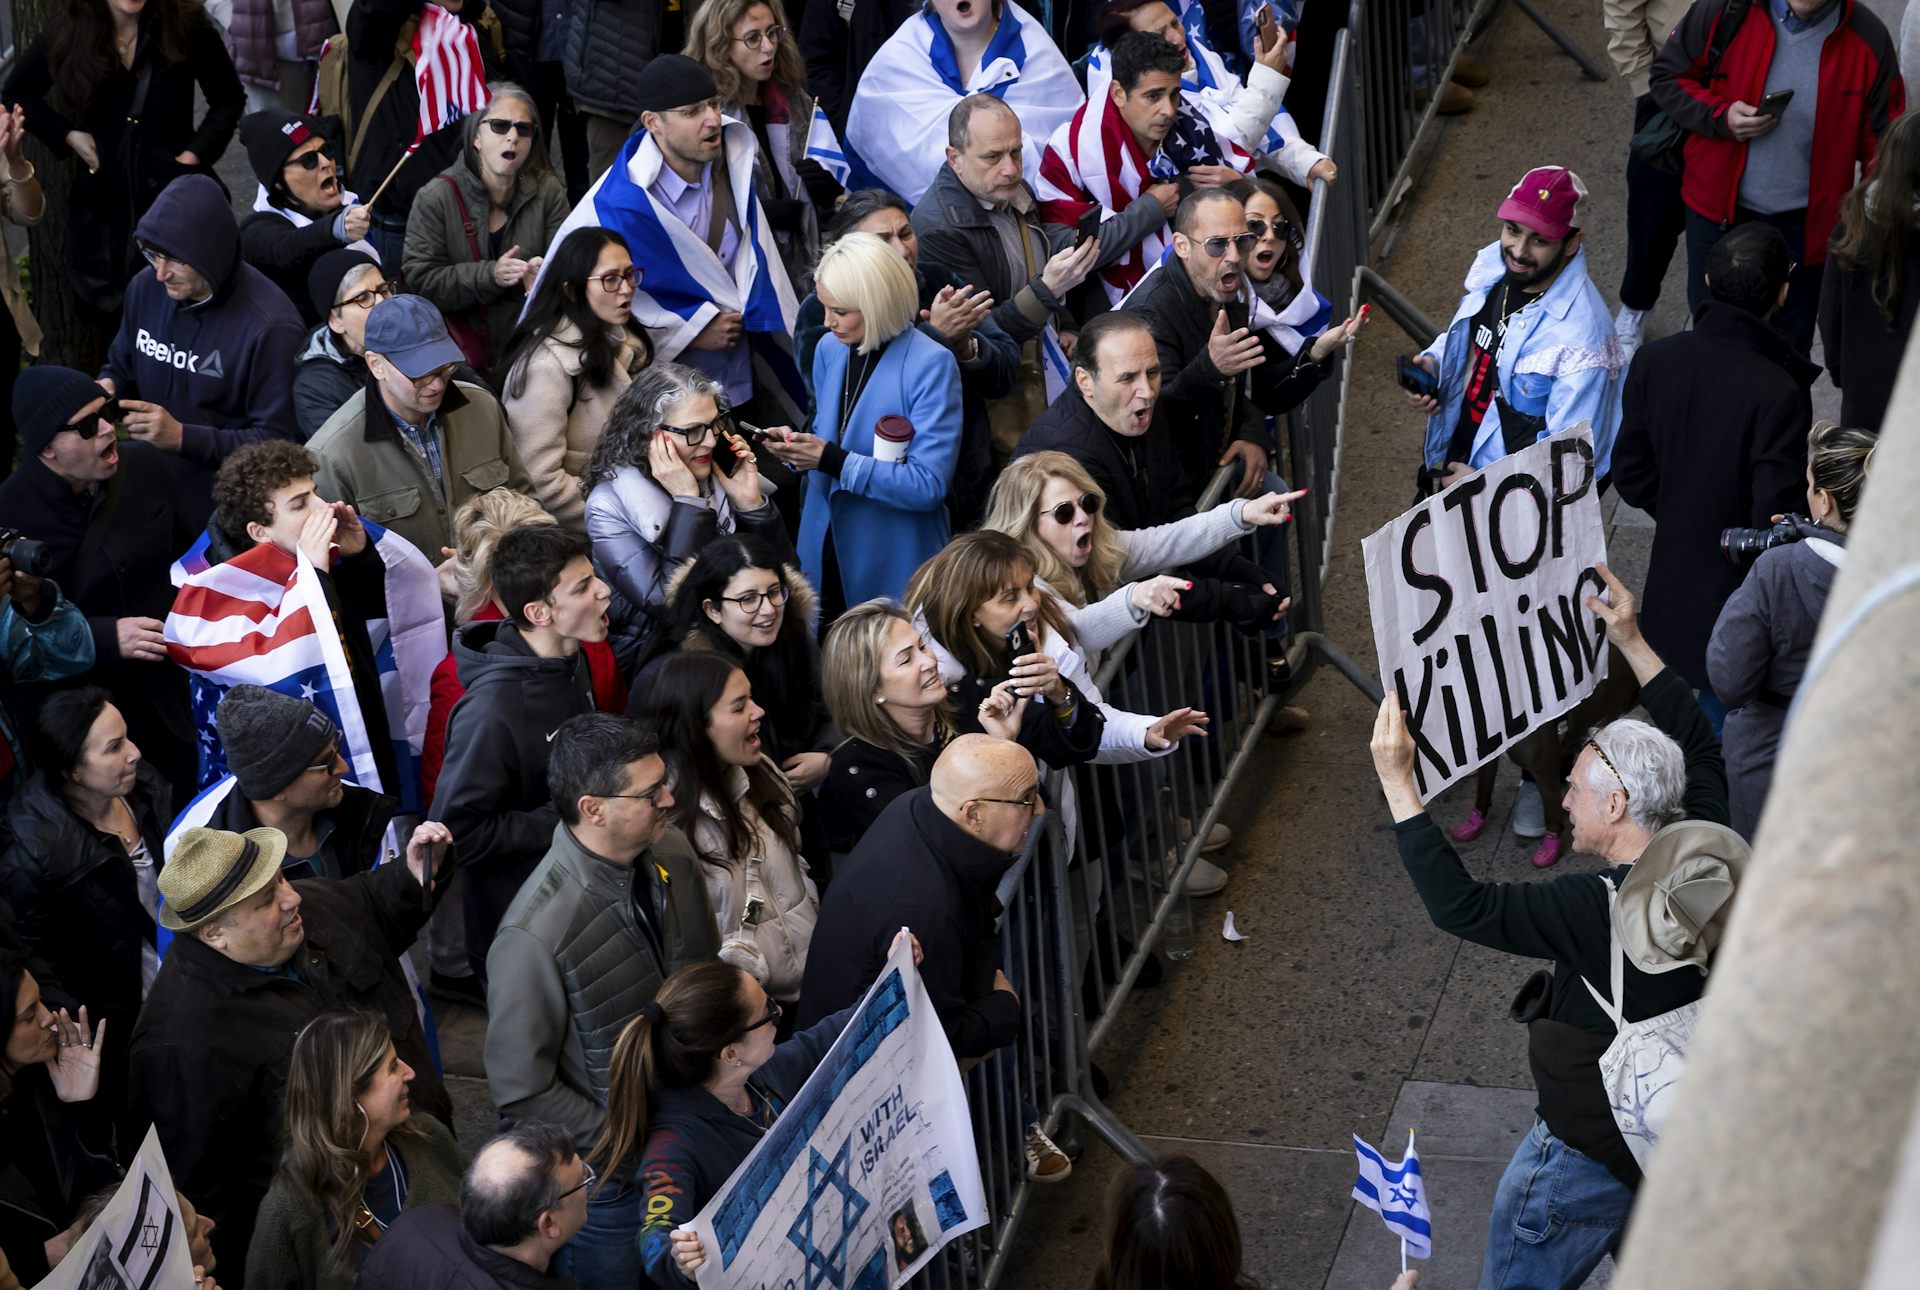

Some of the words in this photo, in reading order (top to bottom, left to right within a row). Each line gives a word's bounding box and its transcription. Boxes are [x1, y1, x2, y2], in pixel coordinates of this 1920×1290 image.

[1401, 437, 1595, 646] STOP
[860, 1083, 903, 1144] WITH
[860, 1103, 917, 1180] ISRAEL
